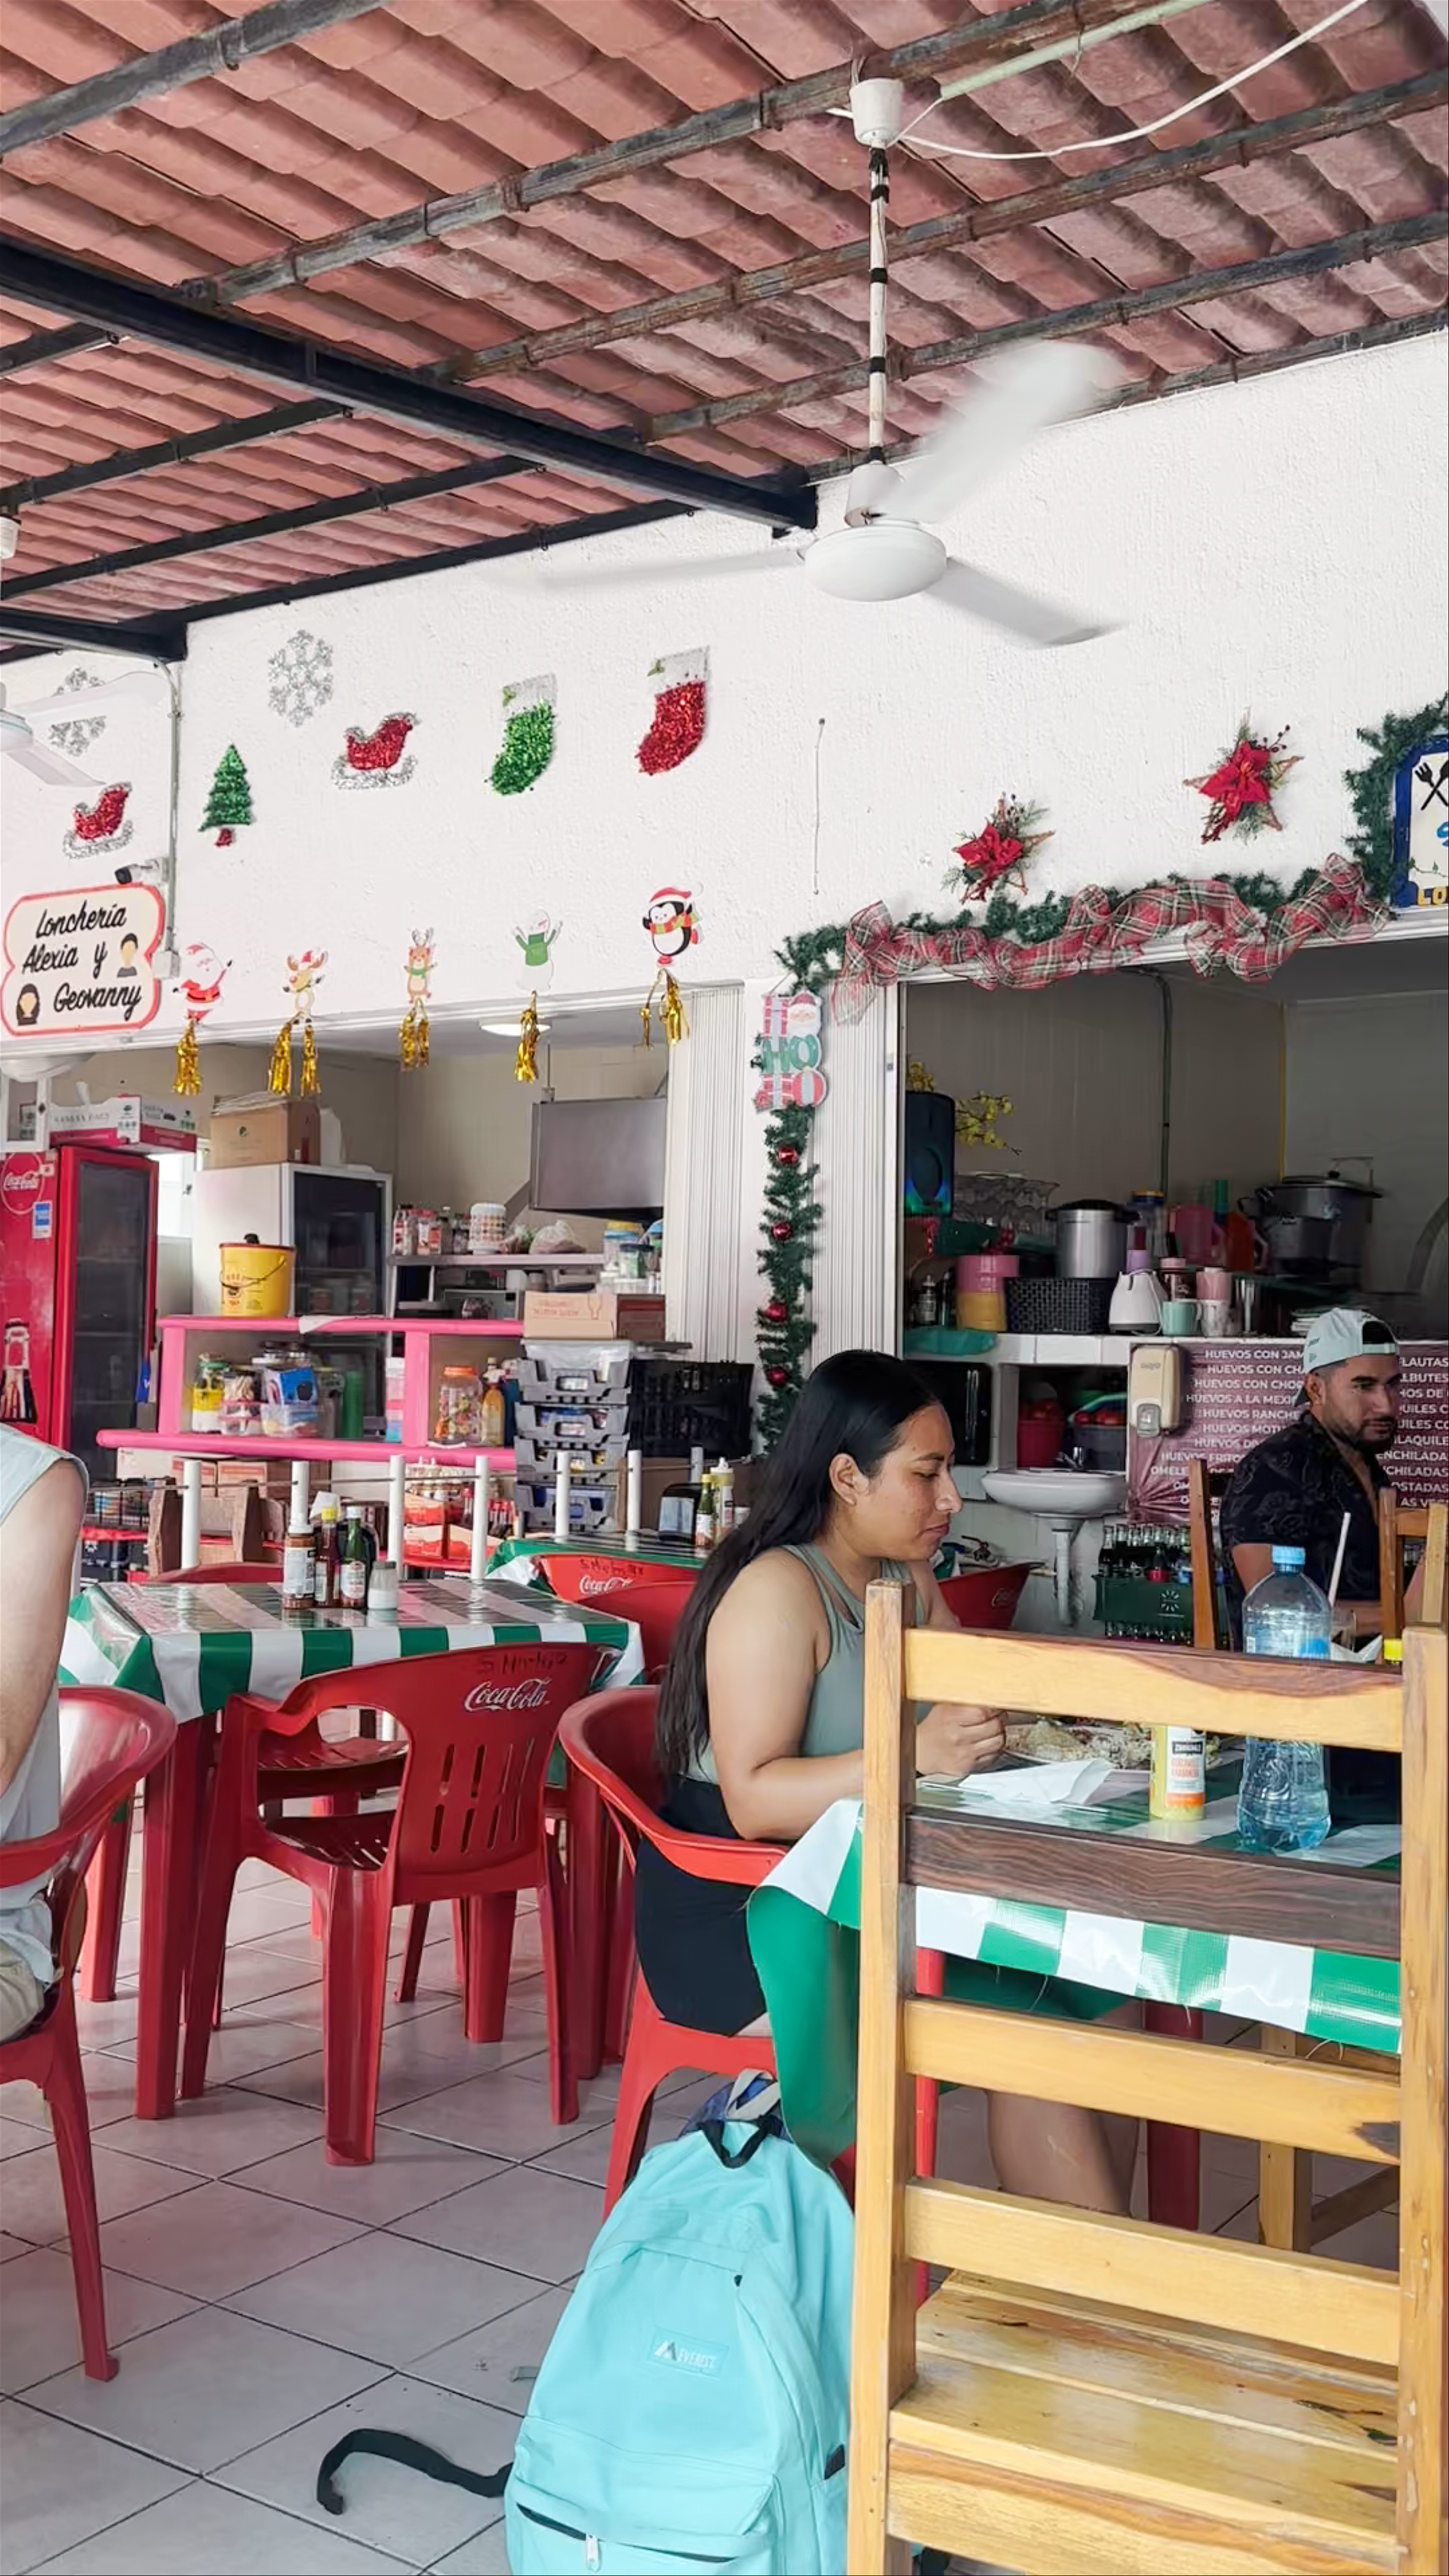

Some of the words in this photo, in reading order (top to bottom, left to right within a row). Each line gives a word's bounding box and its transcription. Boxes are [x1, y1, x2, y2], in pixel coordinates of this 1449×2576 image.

[22, 944, 79, 974] Alexia
[93, 941, 108, 979] y
[53, 982, 142, 1021] Geovanny
[1205, 1350, 1252, 1359] HUEVOS
[1253, 1350, 1279, 1359] CON
[1208, 1364, 1254, 1374] HUEVOS
[1256, 1365, 1281, 1374] CON
[1284, 1365, 1305, 1374] CH
[1400, 1372, 1449, 1383] LBUTES
[1194, 1380, 1241, 1389] HUEVOS
[1242, 1380, 1268, 1389] CON
[1426, 1389, 1443, 1398] DE
[1186, 1394, 1232, 1404] HUEVOS
[1233, 1395, 1243, 1404] A
[1246, 1395, 1261, 1404] LA
[1203, 1409, 1250, 1419] HUEVOS
[1399, 1404, 1437, 1415] UILES
[1203, 1424, 1250, 1433] HUEVOS
[1194, 1438, 1241, 1448] HUEVOS
[1382, 1466, 1449, 1477] CHILADAS
[464, 1677, 552, 1712] Coca-Cola
